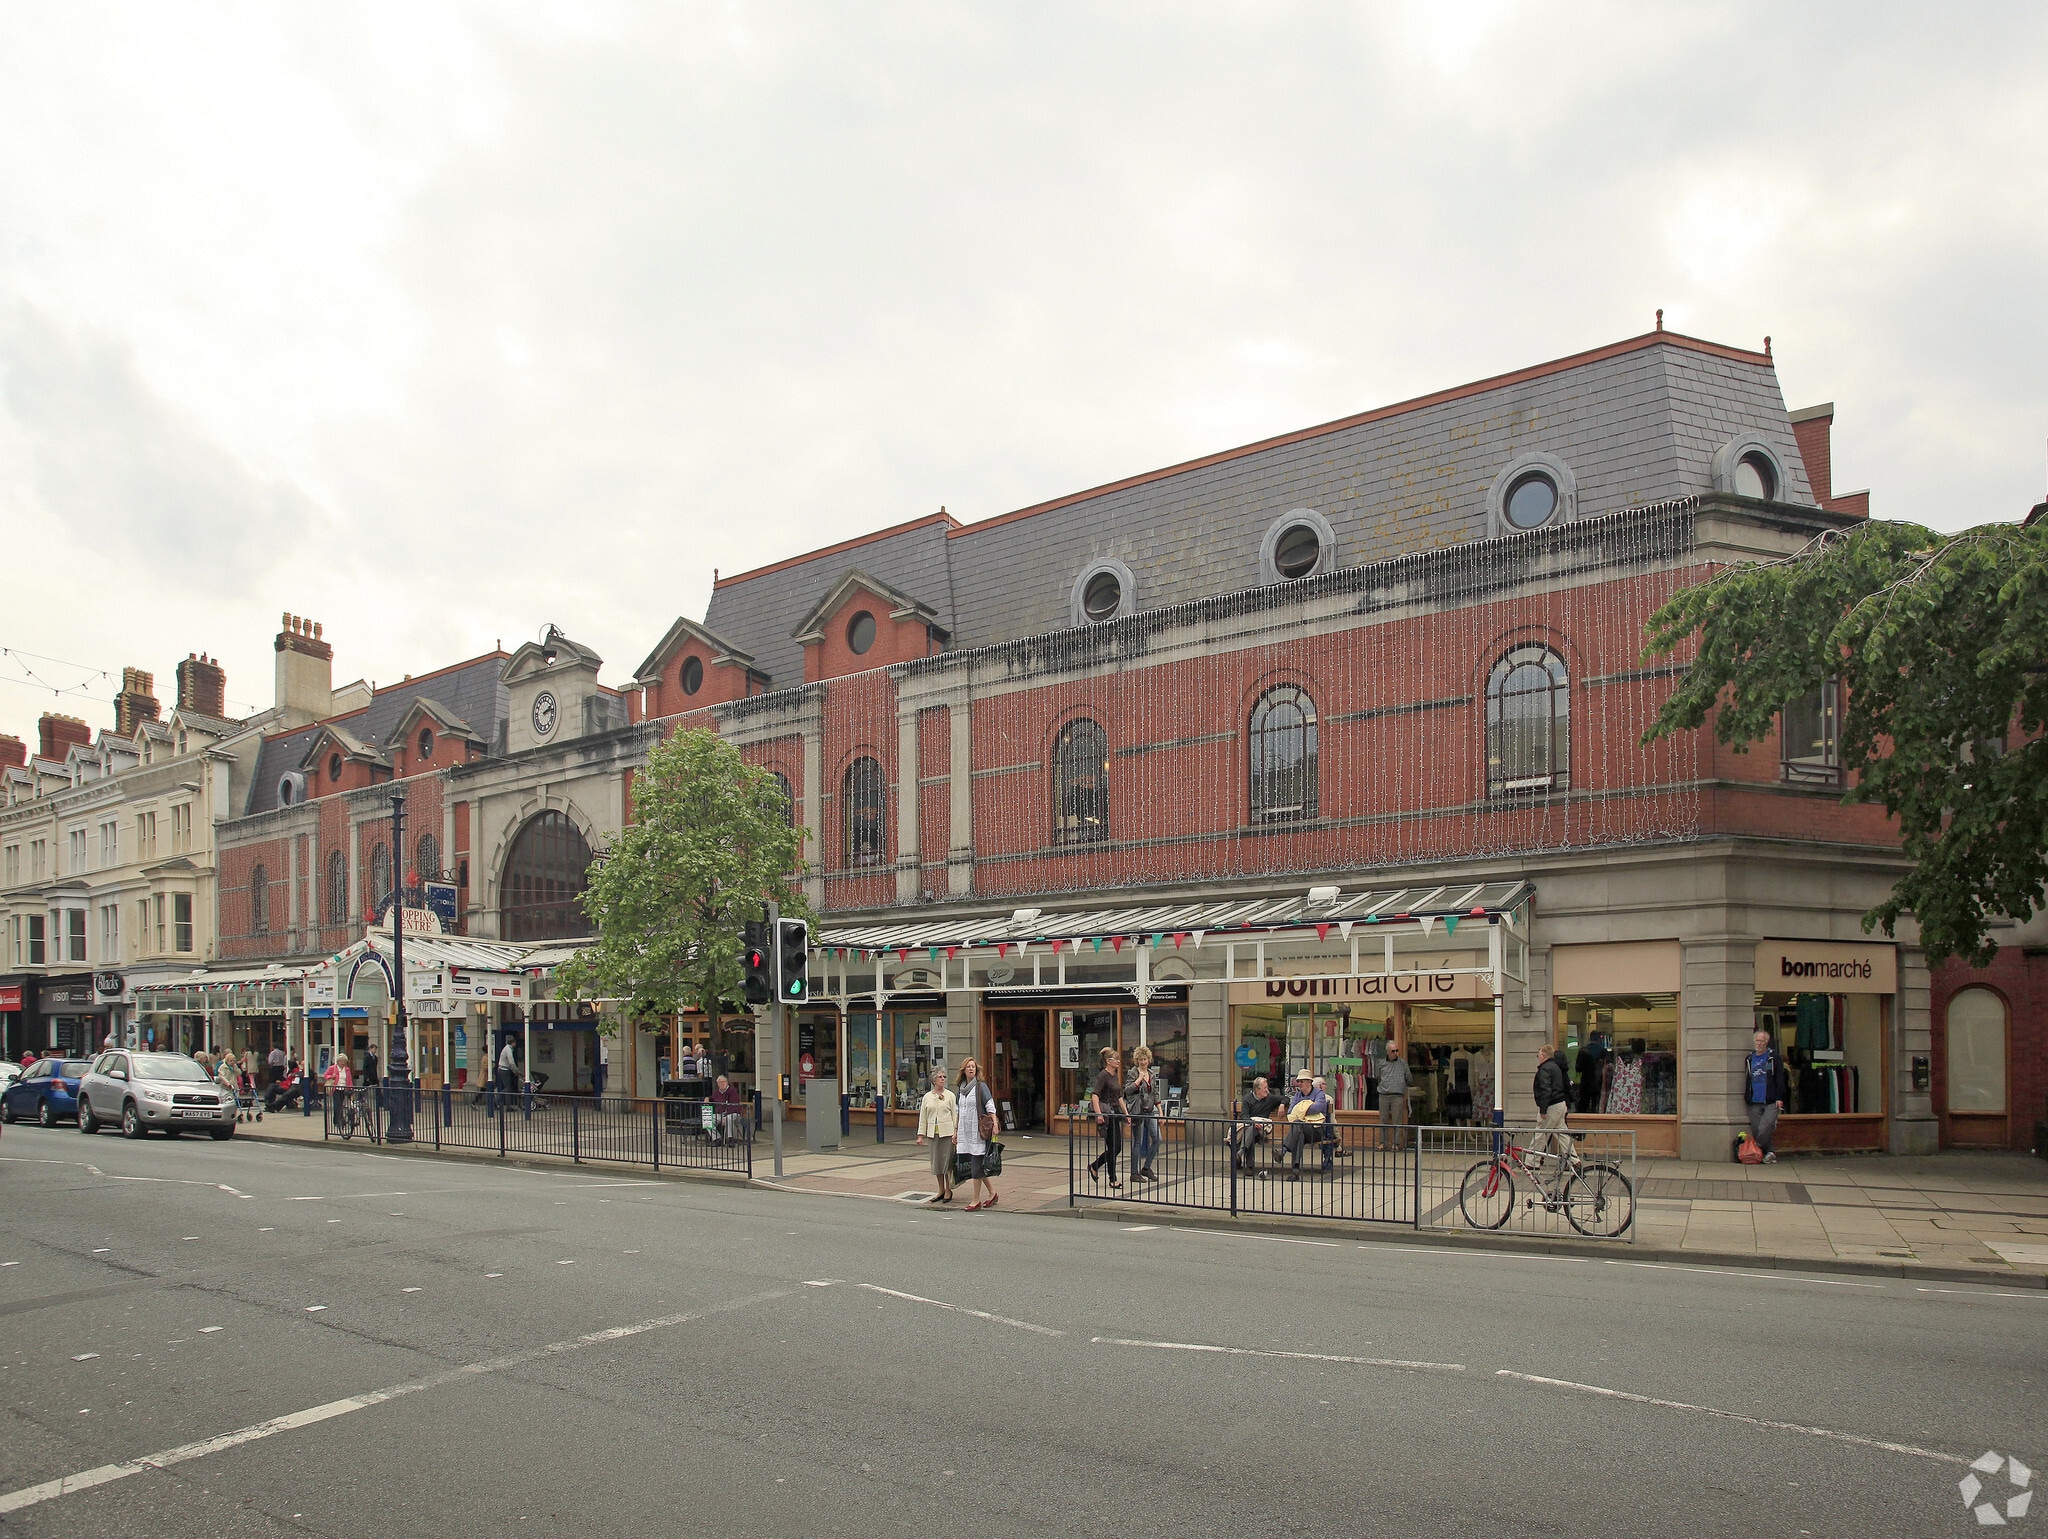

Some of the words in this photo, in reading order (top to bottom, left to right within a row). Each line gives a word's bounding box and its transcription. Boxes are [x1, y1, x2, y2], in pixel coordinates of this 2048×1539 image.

[390, 907, 436, 922] SOPPING
[401, 918, 432, 932] ENTRE
[1781, 957, 1872, 979] bonmarché
[97, 974, 119, 990] Blacks
[1266, 959, 1455, 997] bonmarché
